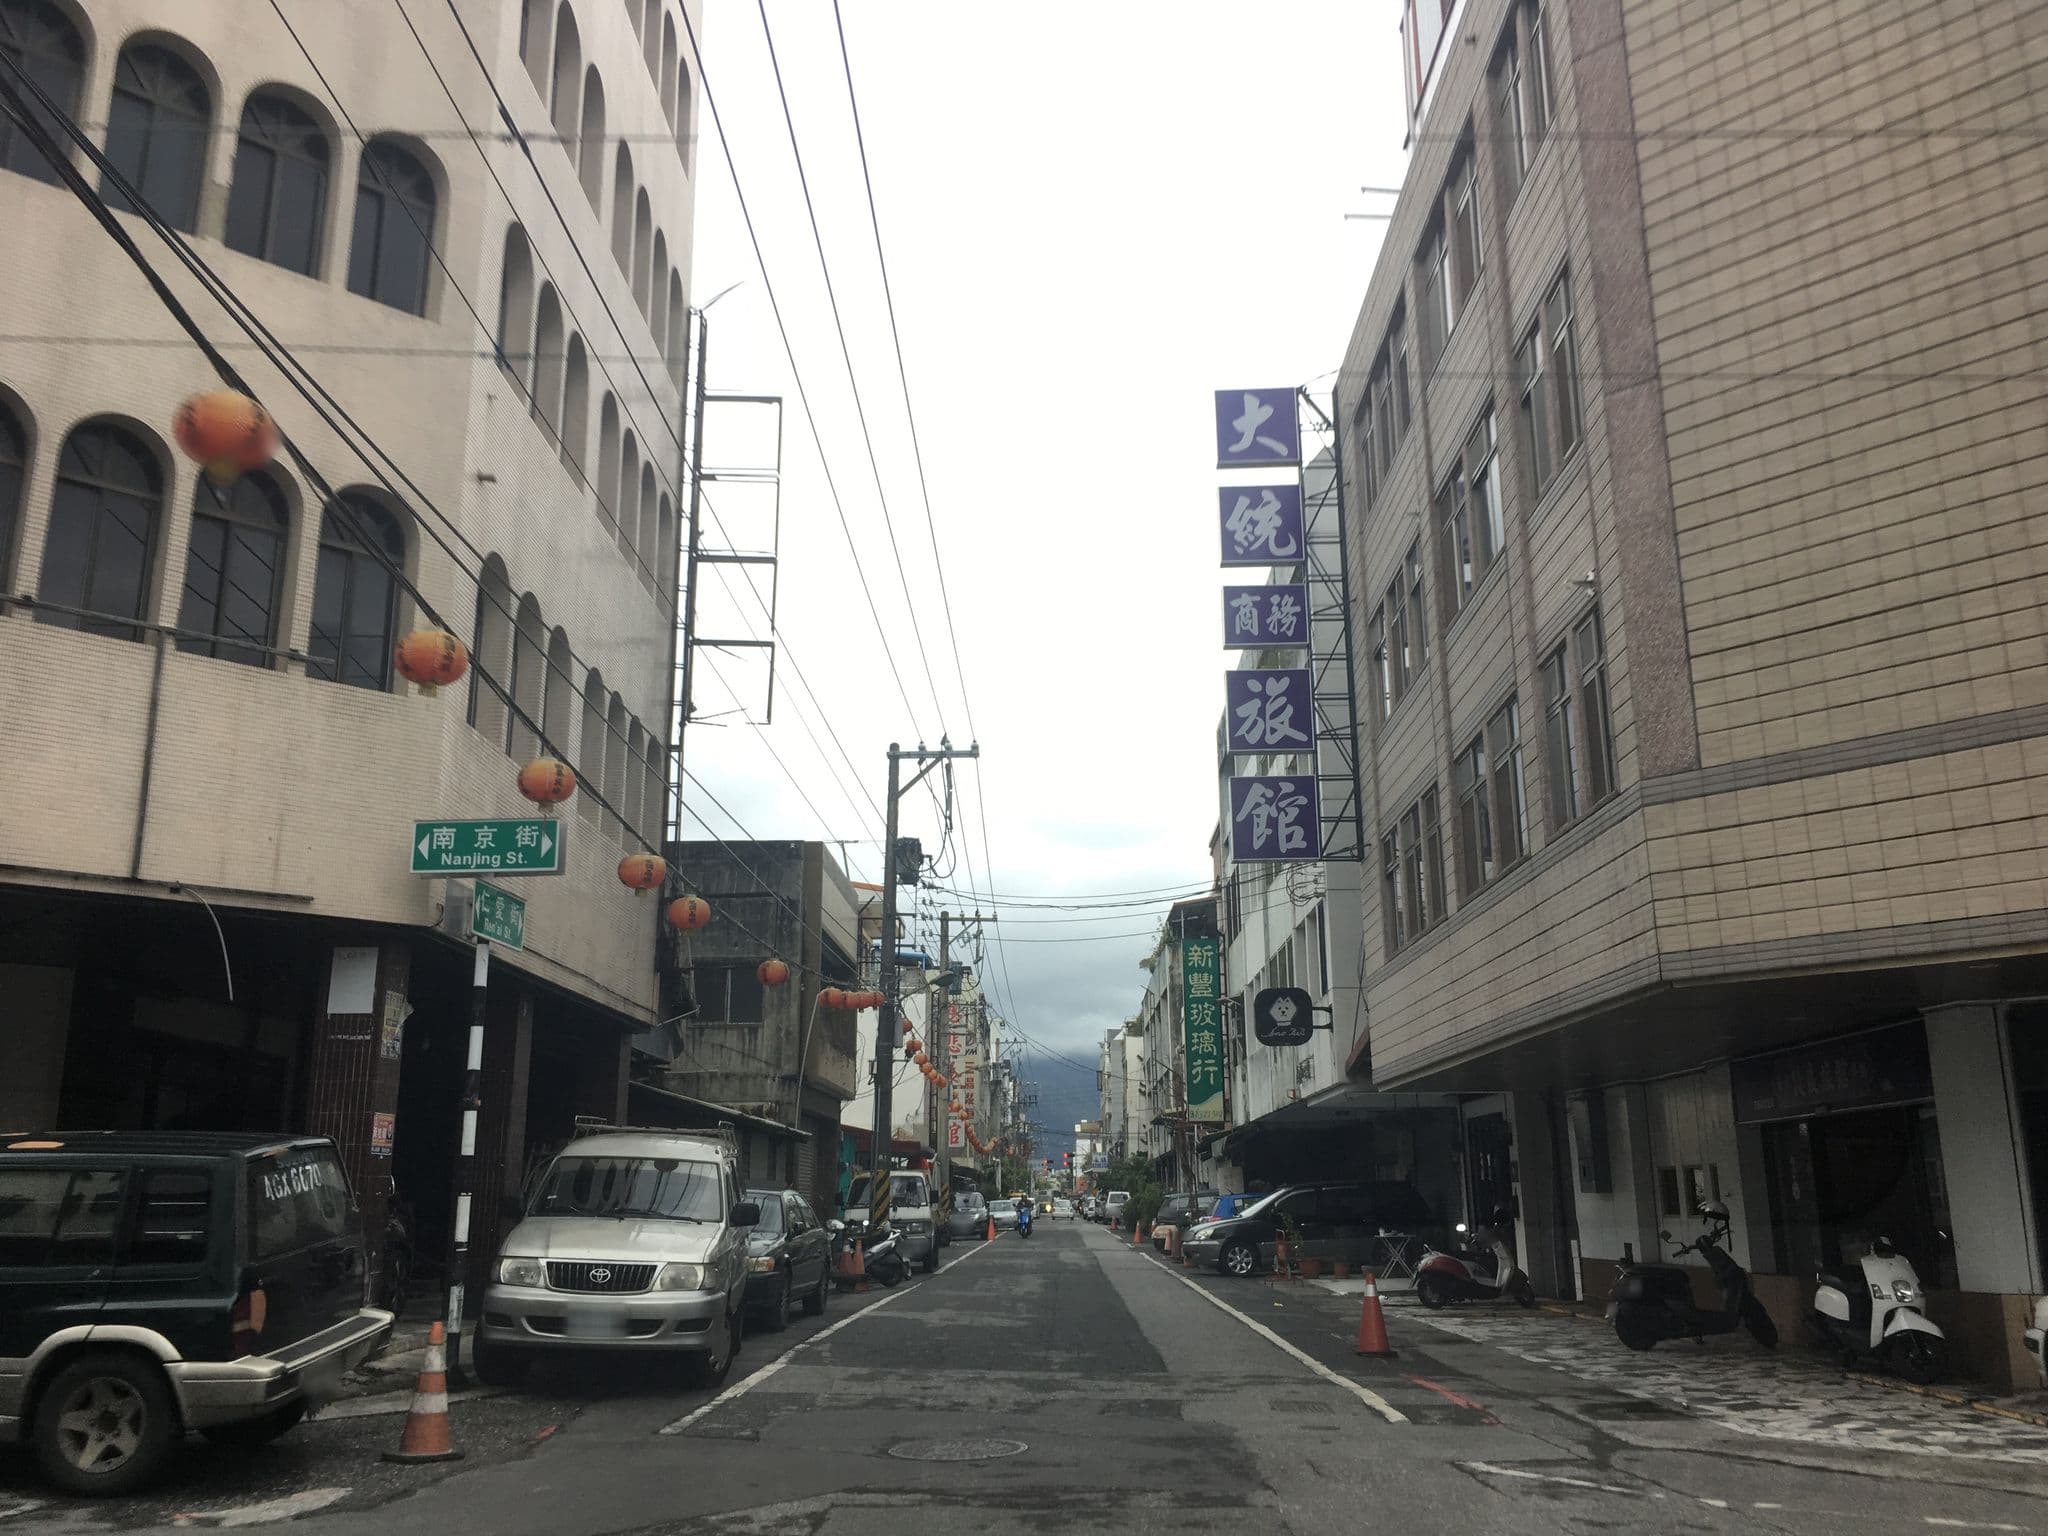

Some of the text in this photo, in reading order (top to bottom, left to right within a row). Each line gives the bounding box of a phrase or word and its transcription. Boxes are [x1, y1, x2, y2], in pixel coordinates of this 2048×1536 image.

[1225, 393, 1308, 853] 大統商務旅館
[432, 825, 539, 850] 南京街
[441, 851, 527, 868] Nanjing St.
[1188, 944, 1218, 1085] 新豐玻璃行
